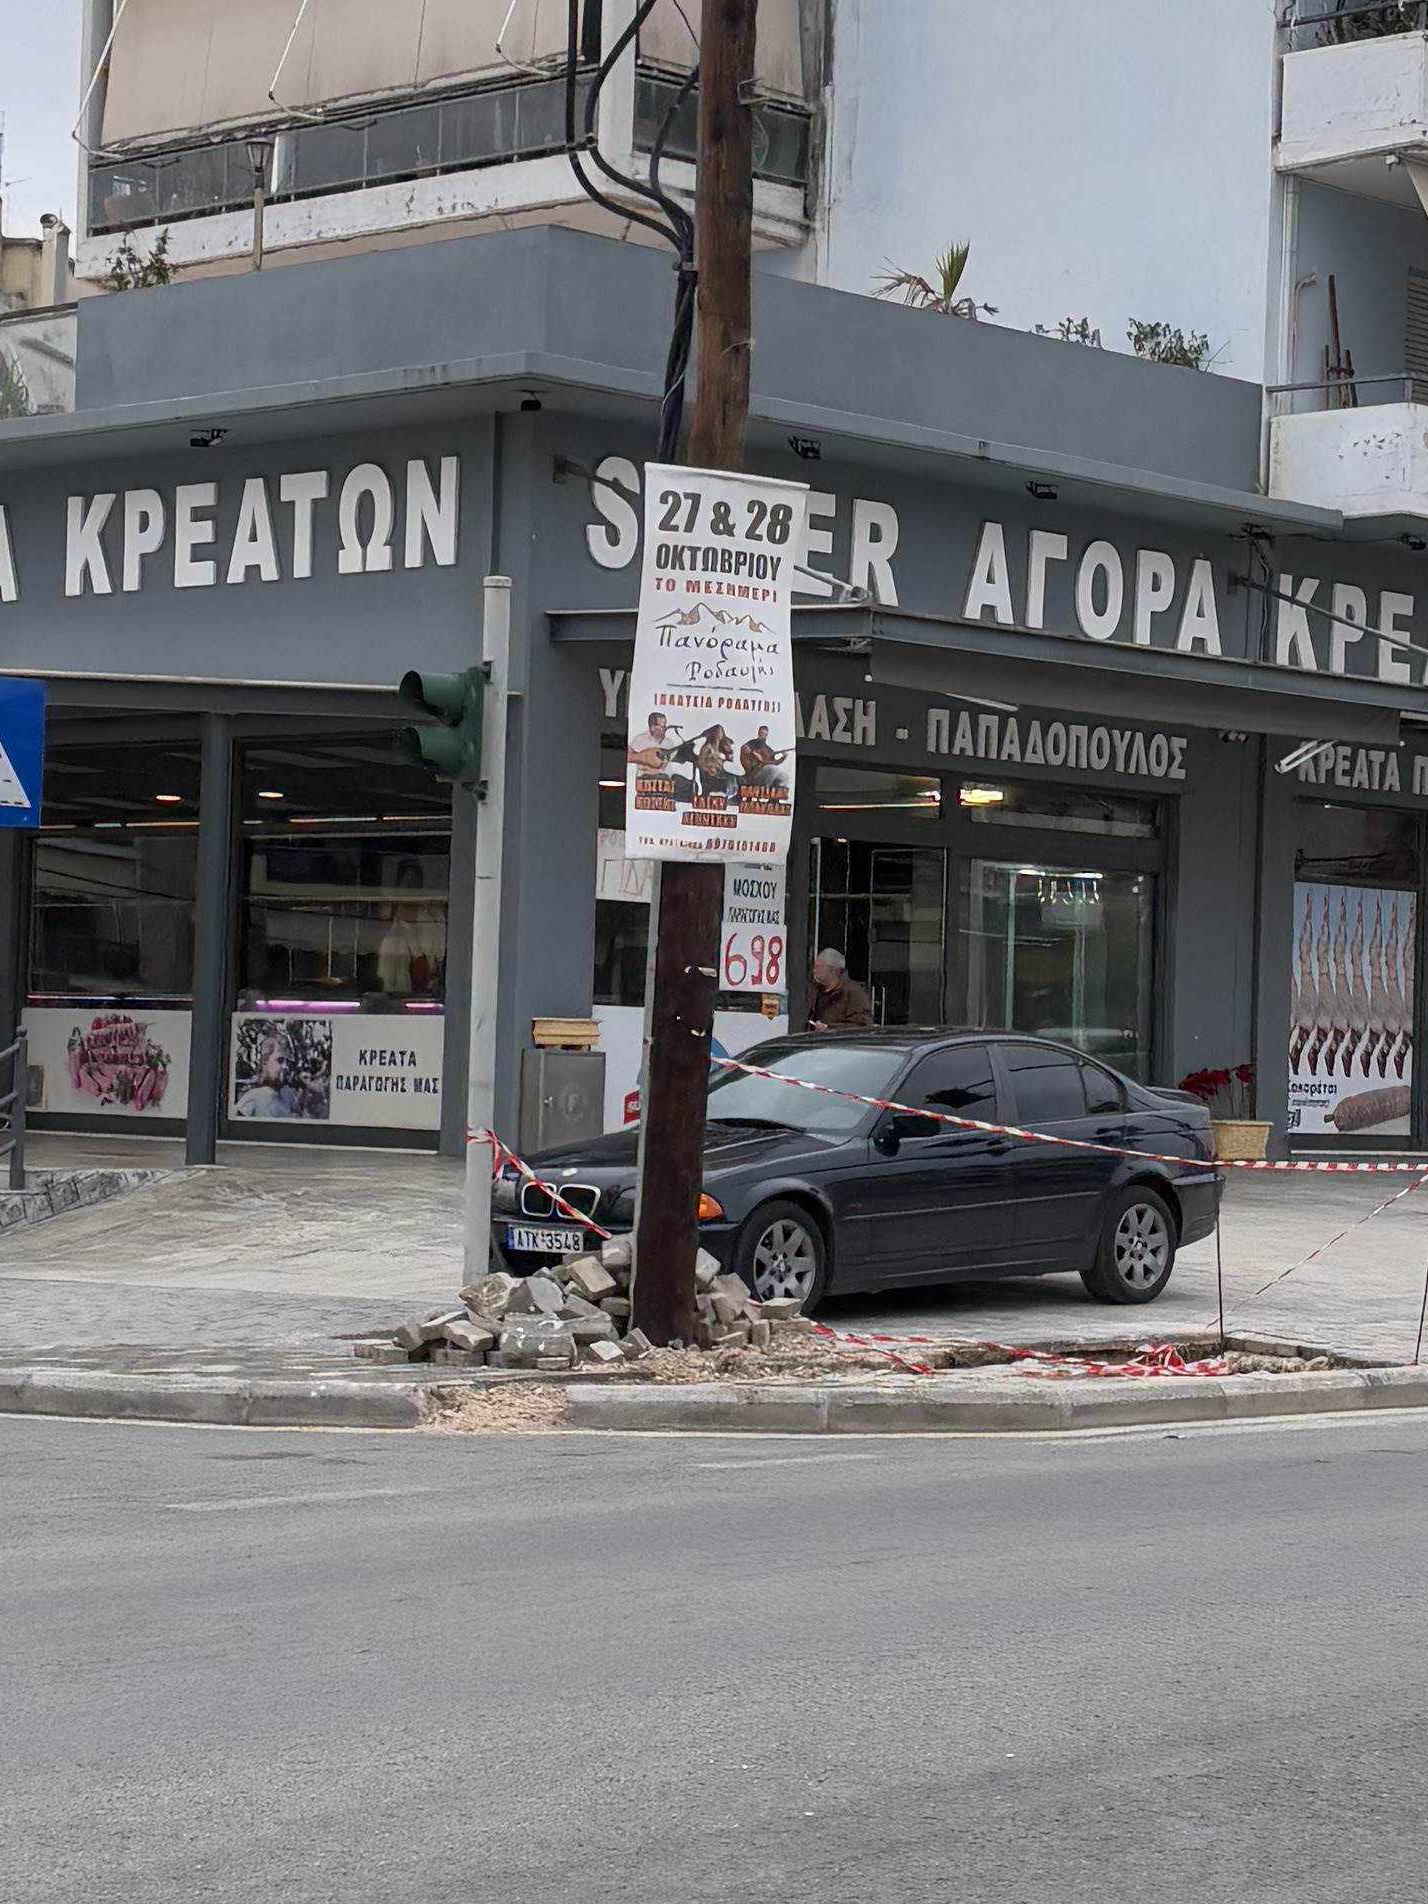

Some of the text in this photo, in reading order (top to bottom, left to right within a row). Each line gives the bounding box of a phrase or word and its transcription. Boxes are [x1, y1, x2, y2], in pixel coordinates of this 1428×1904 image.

[64, 455, 459, 597] ΚΡΕΑΤΩΝ
[658, 490, 793, 545] 27 & 28
[586, 456, 900, 606] SER
[963, 520, 1222, 656] ΑΓΟΡΑ
[656, 543, 782, 581] ΟΚΤΩΒΡΙΟΥ
[654, 577, 777, 603] ΤΟ ΜΕΣΗΜΕΡΙ
[655, 625, 779, 662] Πανόραμα
[927, 708, 1188, 780] ΠΑΠΑΔΟΠΟΥΛΟΣ
[1299, 742, 1401, 791] ΚΡΕΑΤΑ
[733, 878, 777, 899] ΜΟΣΧΟΥ
[359, 1049, 417, 1067] ΚΡΕΑΤΑ
[336, 1075, 438, 1094] ΠΑΡΑΓΩΓΗΣ ΜΑΣ
